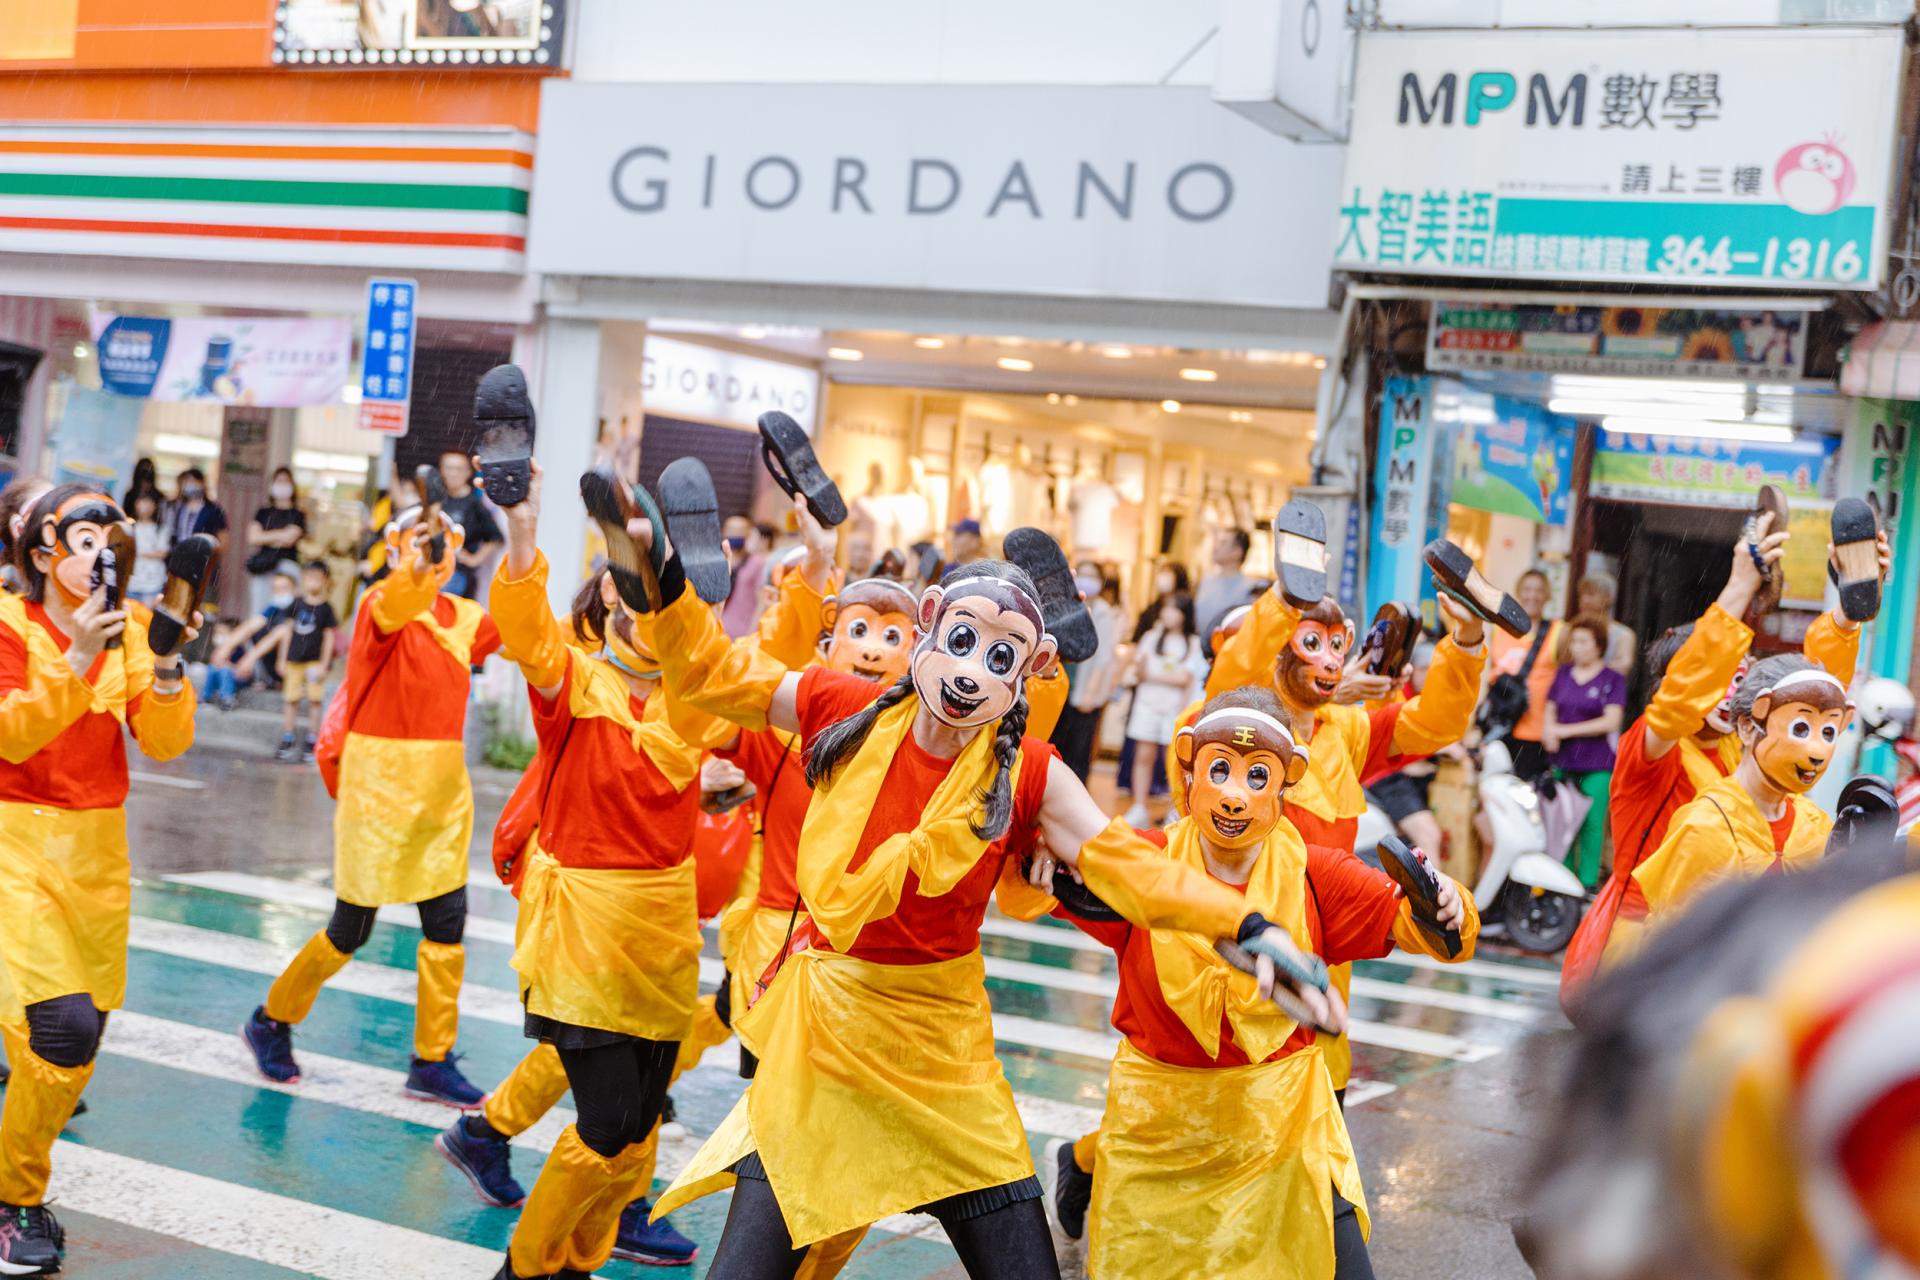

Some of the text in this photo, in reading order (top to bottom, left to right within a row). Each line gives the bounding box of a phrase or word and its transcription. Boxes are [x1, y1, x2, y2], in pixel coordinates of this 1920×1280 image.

[1398, 72, 1722, 130] MPM 數學
[609, 144, 1236, 223] GIORDANO
[1621, 162, 1763, 196] 請上三樓
[1335, 186, 1494, 265] 大智美語
[1656, 235, 1863, 281] 364-1316
[1389, 397, 1422, 482] MPM
